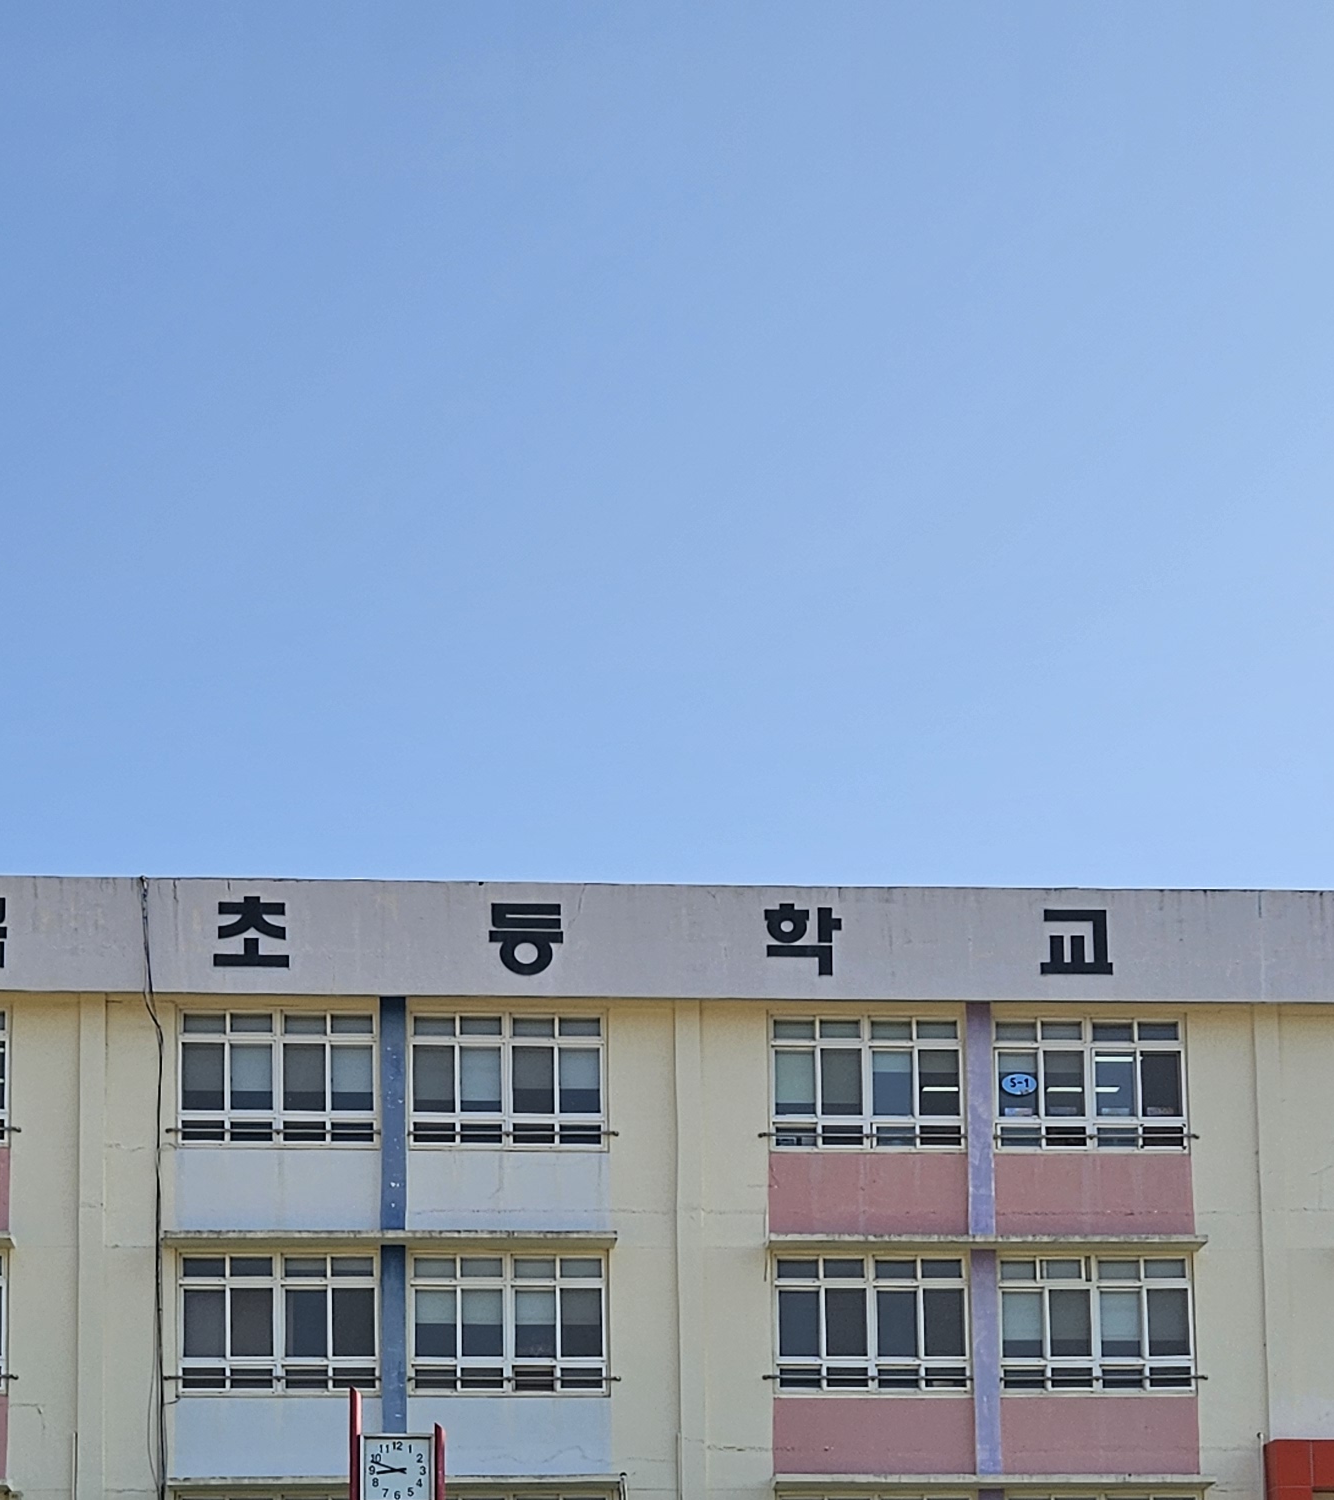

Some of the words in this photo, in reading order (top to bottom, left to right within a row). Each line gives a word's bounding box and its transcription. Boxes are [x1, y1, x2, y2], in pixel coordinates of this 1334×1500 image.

[1010, 1077, 1029, 1088] 5-1
[379, 1444, 389, 1453] 11
[392, 1441, 403, 1451] 12
[408, 1444, 412, 1453] 1
[370, 1453, 382, 1463] 10
[416, 1453, 423, 1463] 2
[368, 1465, 376, 1475] 9
[419, 1466, 426, 1475] 3
[372, 1477, 379, 1487] 8
[416, 1478, 423, 1487] 4
[382, 1488, 389, 1497] 7
[394, 1491, 401, 1500] 6
[407, 1487, 414, 1496] 5
